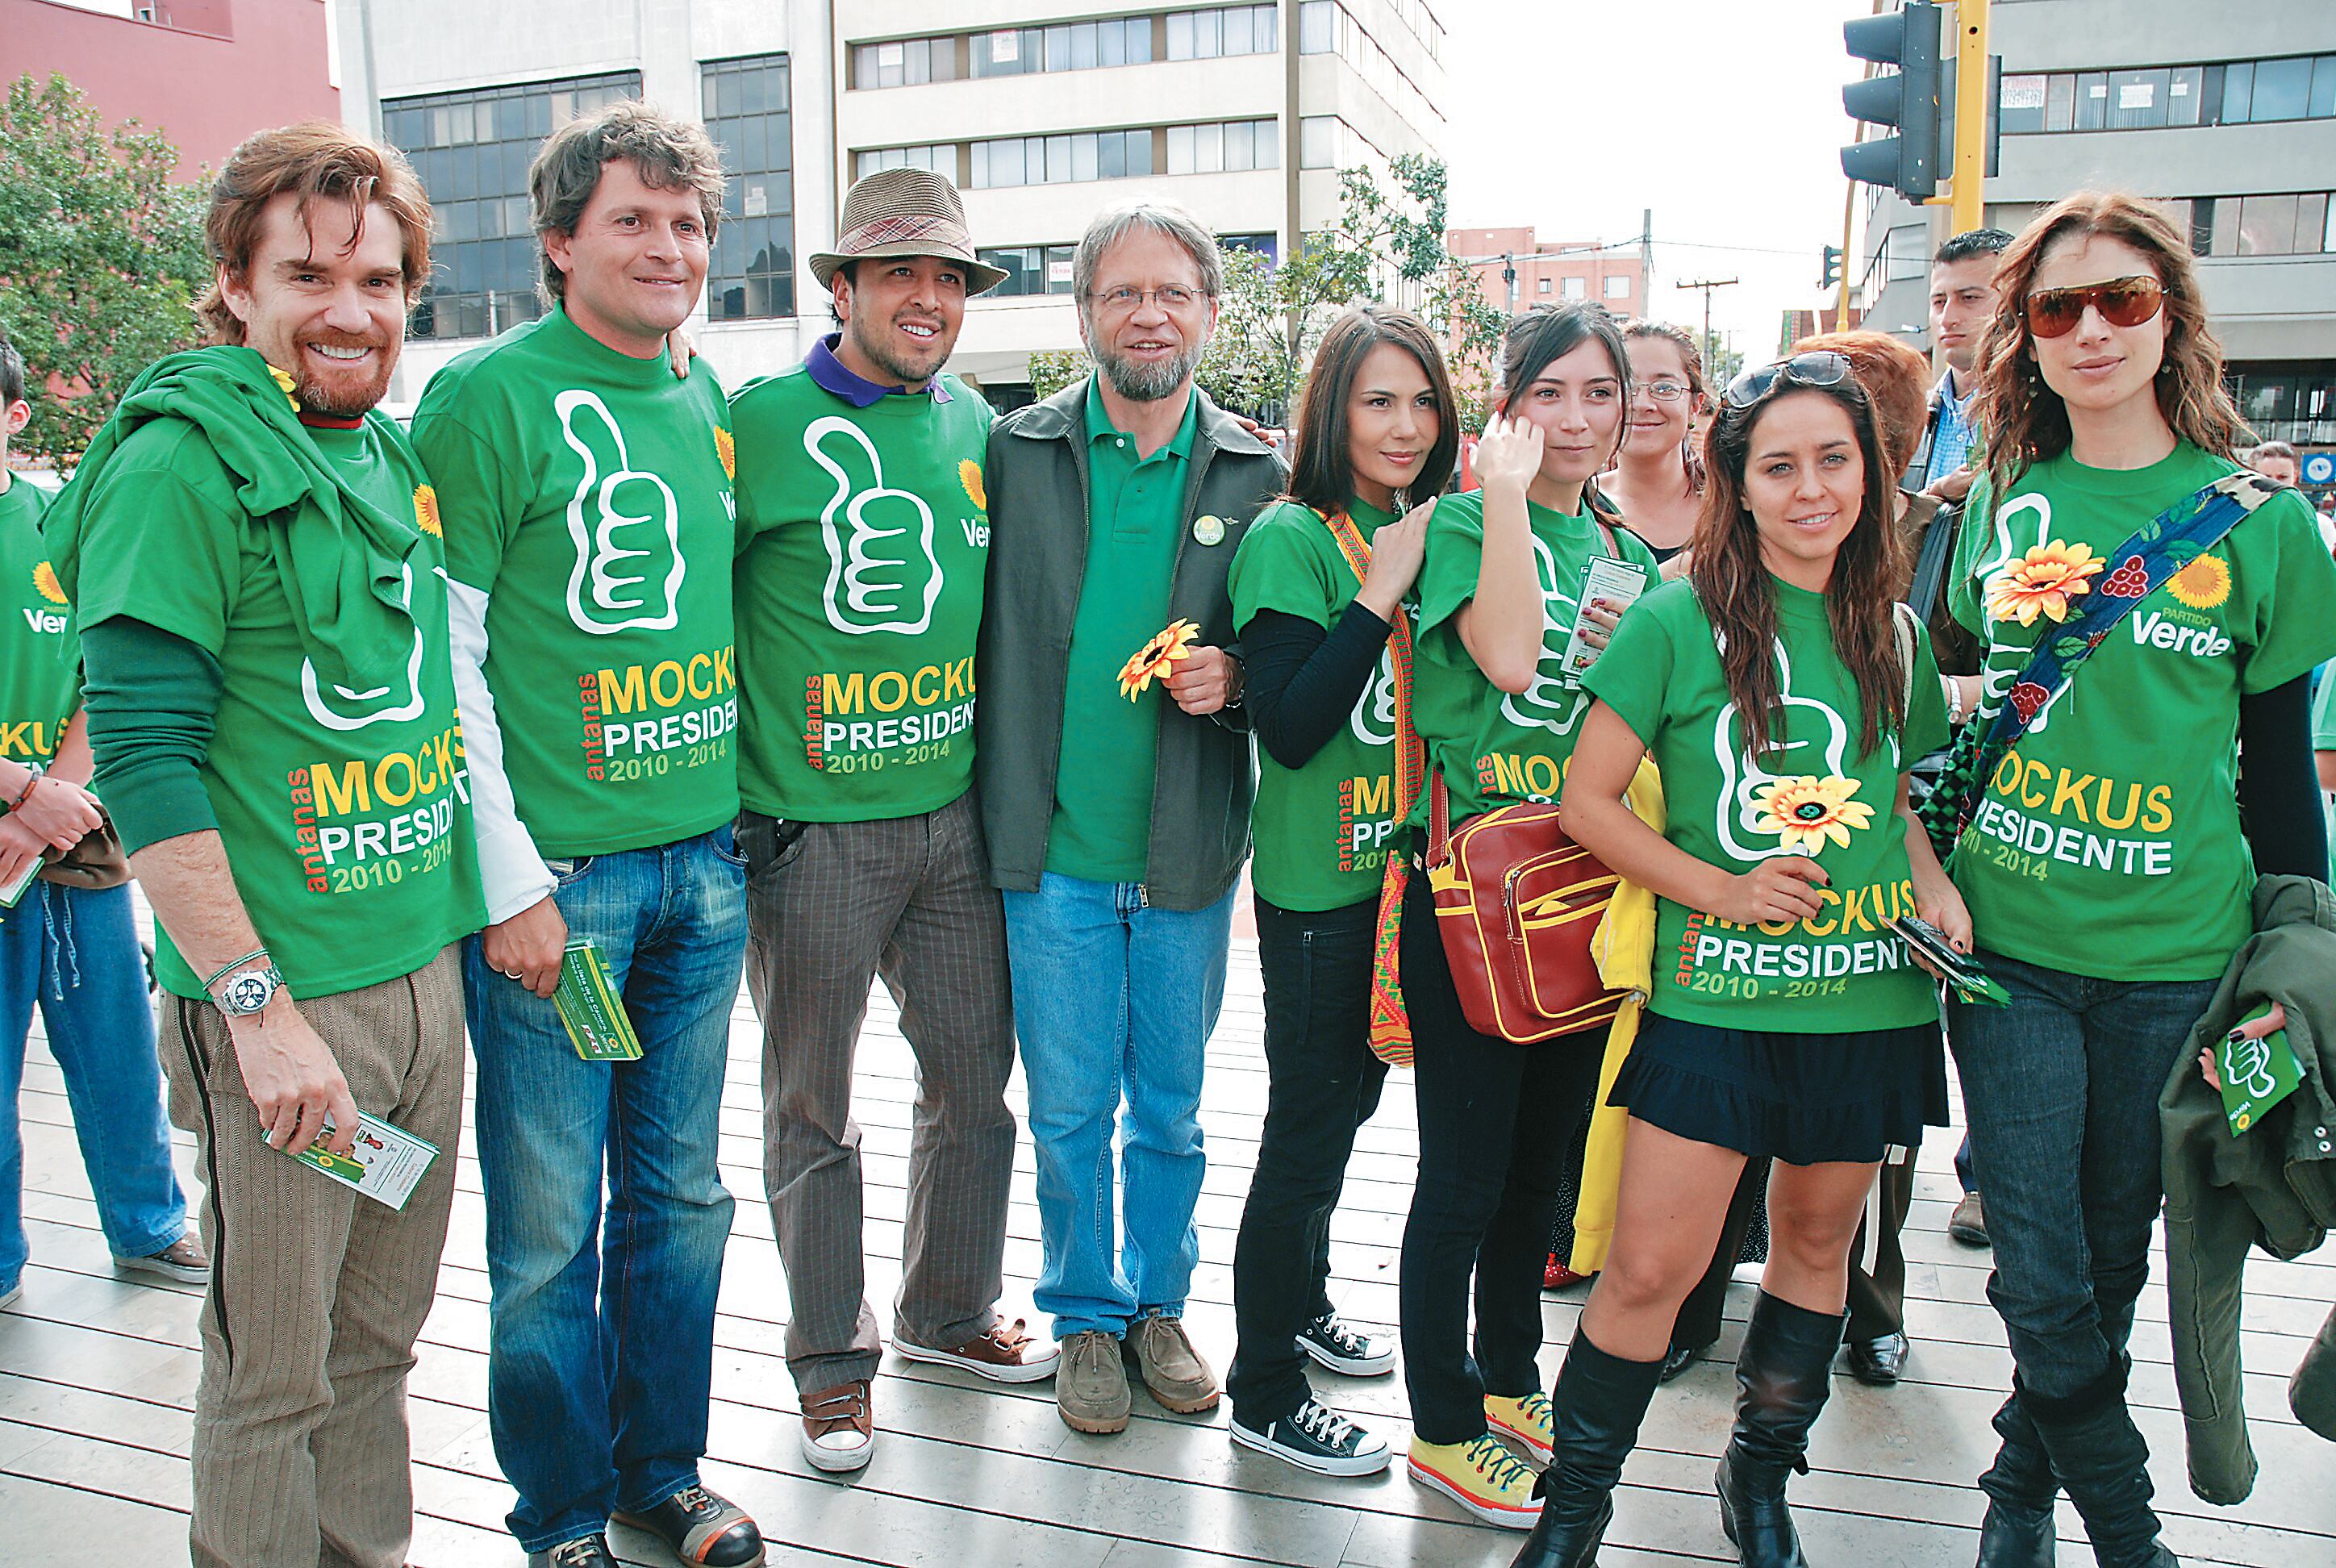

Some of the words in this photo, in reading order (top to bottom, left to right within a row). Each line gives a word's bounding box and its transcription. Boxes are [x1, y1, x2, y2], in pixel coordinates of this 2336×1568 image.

[960, 518, 991, 548] Ver
[23, 608, 67, 633] Ver
[2132, 610, 2230, 657] Verde
[2163, 607, 2212, 627] PARTIDO
[598, 645, 736, 715] MOCK
[823, 656, 975, 715] MOCKU
[578, 673, 605, 781] antanas
[604, 694, 738, 757] PRESIDEN
[803, 675, 823, 770] antanas
[824, 698, 976, 752] PRESIDEN
[609, 754, 669, 782] 2010
[688, 739, 726, 768] 2014
[827, 752, 884, 774] 2010
[905, 740, 950, 765] 2014
[1989, 750, 2173, 833] OCKUS
[288, 768, 328, 893] antanas
[1336, 779, 1353, 872] antanas
[332, 859, 403, 894] 2010
[1354, 849, 1387, 871] 201
[1993, 844, 2048, 881] 2014
[1675, 913, 1704, 986] antan
[1695, 935, 1913, 978] PRESIDENT
[1692, 971, 1759, 999] 2010
[1784, 978, 1847, 999] 2014
